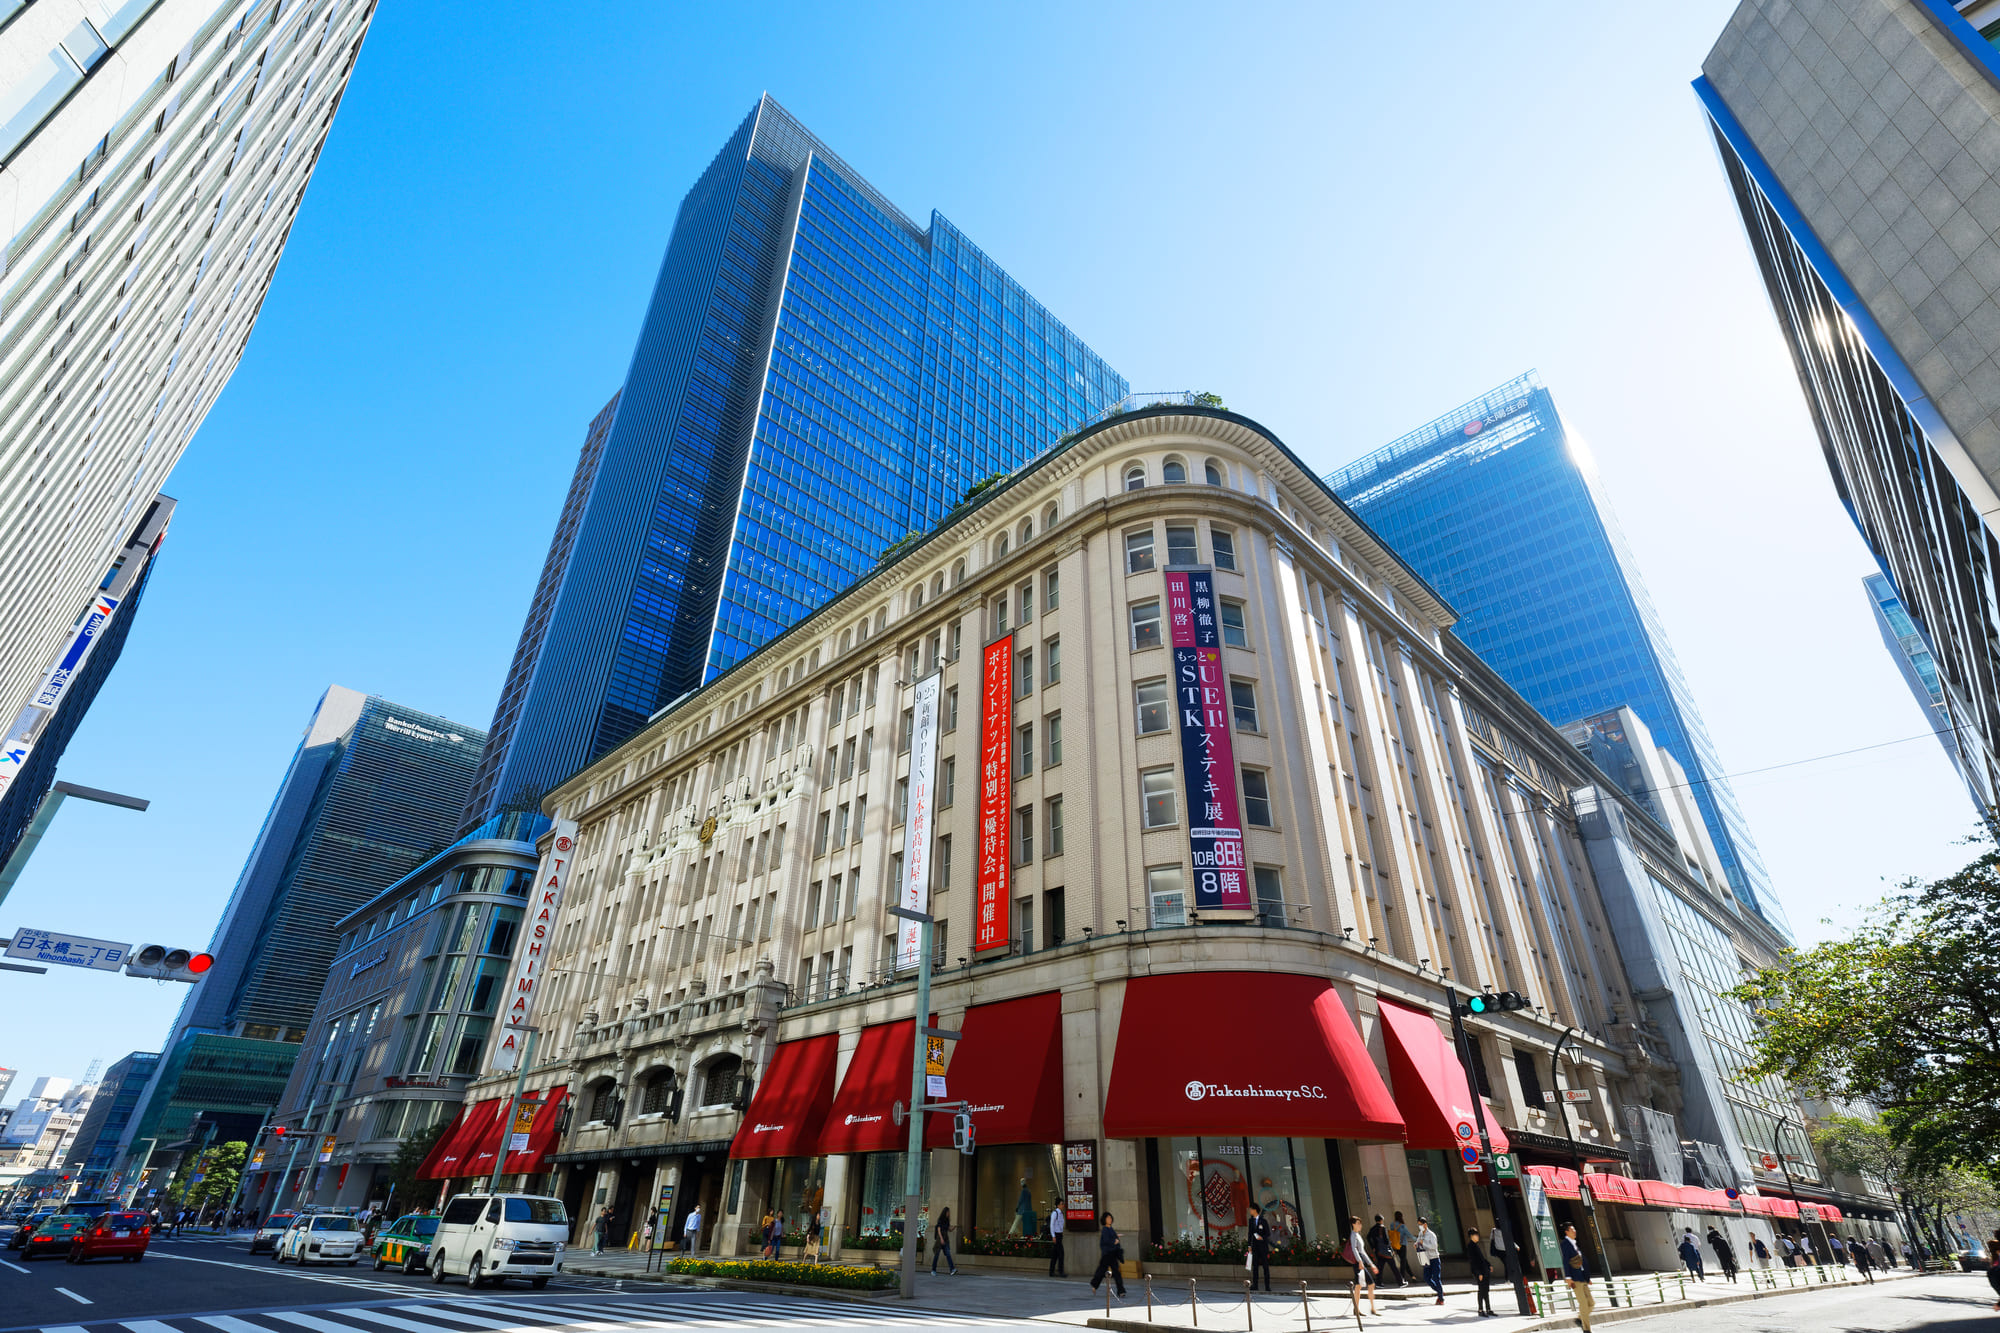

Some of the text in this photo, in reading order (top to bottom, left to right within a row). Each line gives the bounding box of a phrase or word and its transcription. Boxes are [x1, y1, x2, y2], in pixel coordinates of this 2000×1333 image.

[1483, 398, 1528, 426] 太陽生命
[1171, 582, 1190, 642] 田川啓二
[1195, 581, 1214, 643] 黒柳徹子
[84, 614, 105, 637] MITO
[1178, 651, 1207, 662] もっと
[39, 668, 71, 705] 水戸証券
[384, 722, 433, 742] Merrill Lynch
[981, 881, 996, 943] 開催中
[24, 928, 50, 939] 中央区
[17, 936, 122, 962] 日本橋二丁目
[37, 951, 84, 965] Nihonbashi
[502, 858, 565, 1049] TAKASHIMAYA
[1206, 1084, 1328, 1101] Takashimaya S.C.
[967, 1103, 1005, 1113] Takashimaya
[1460, 1126, 1471, 1136] 30
